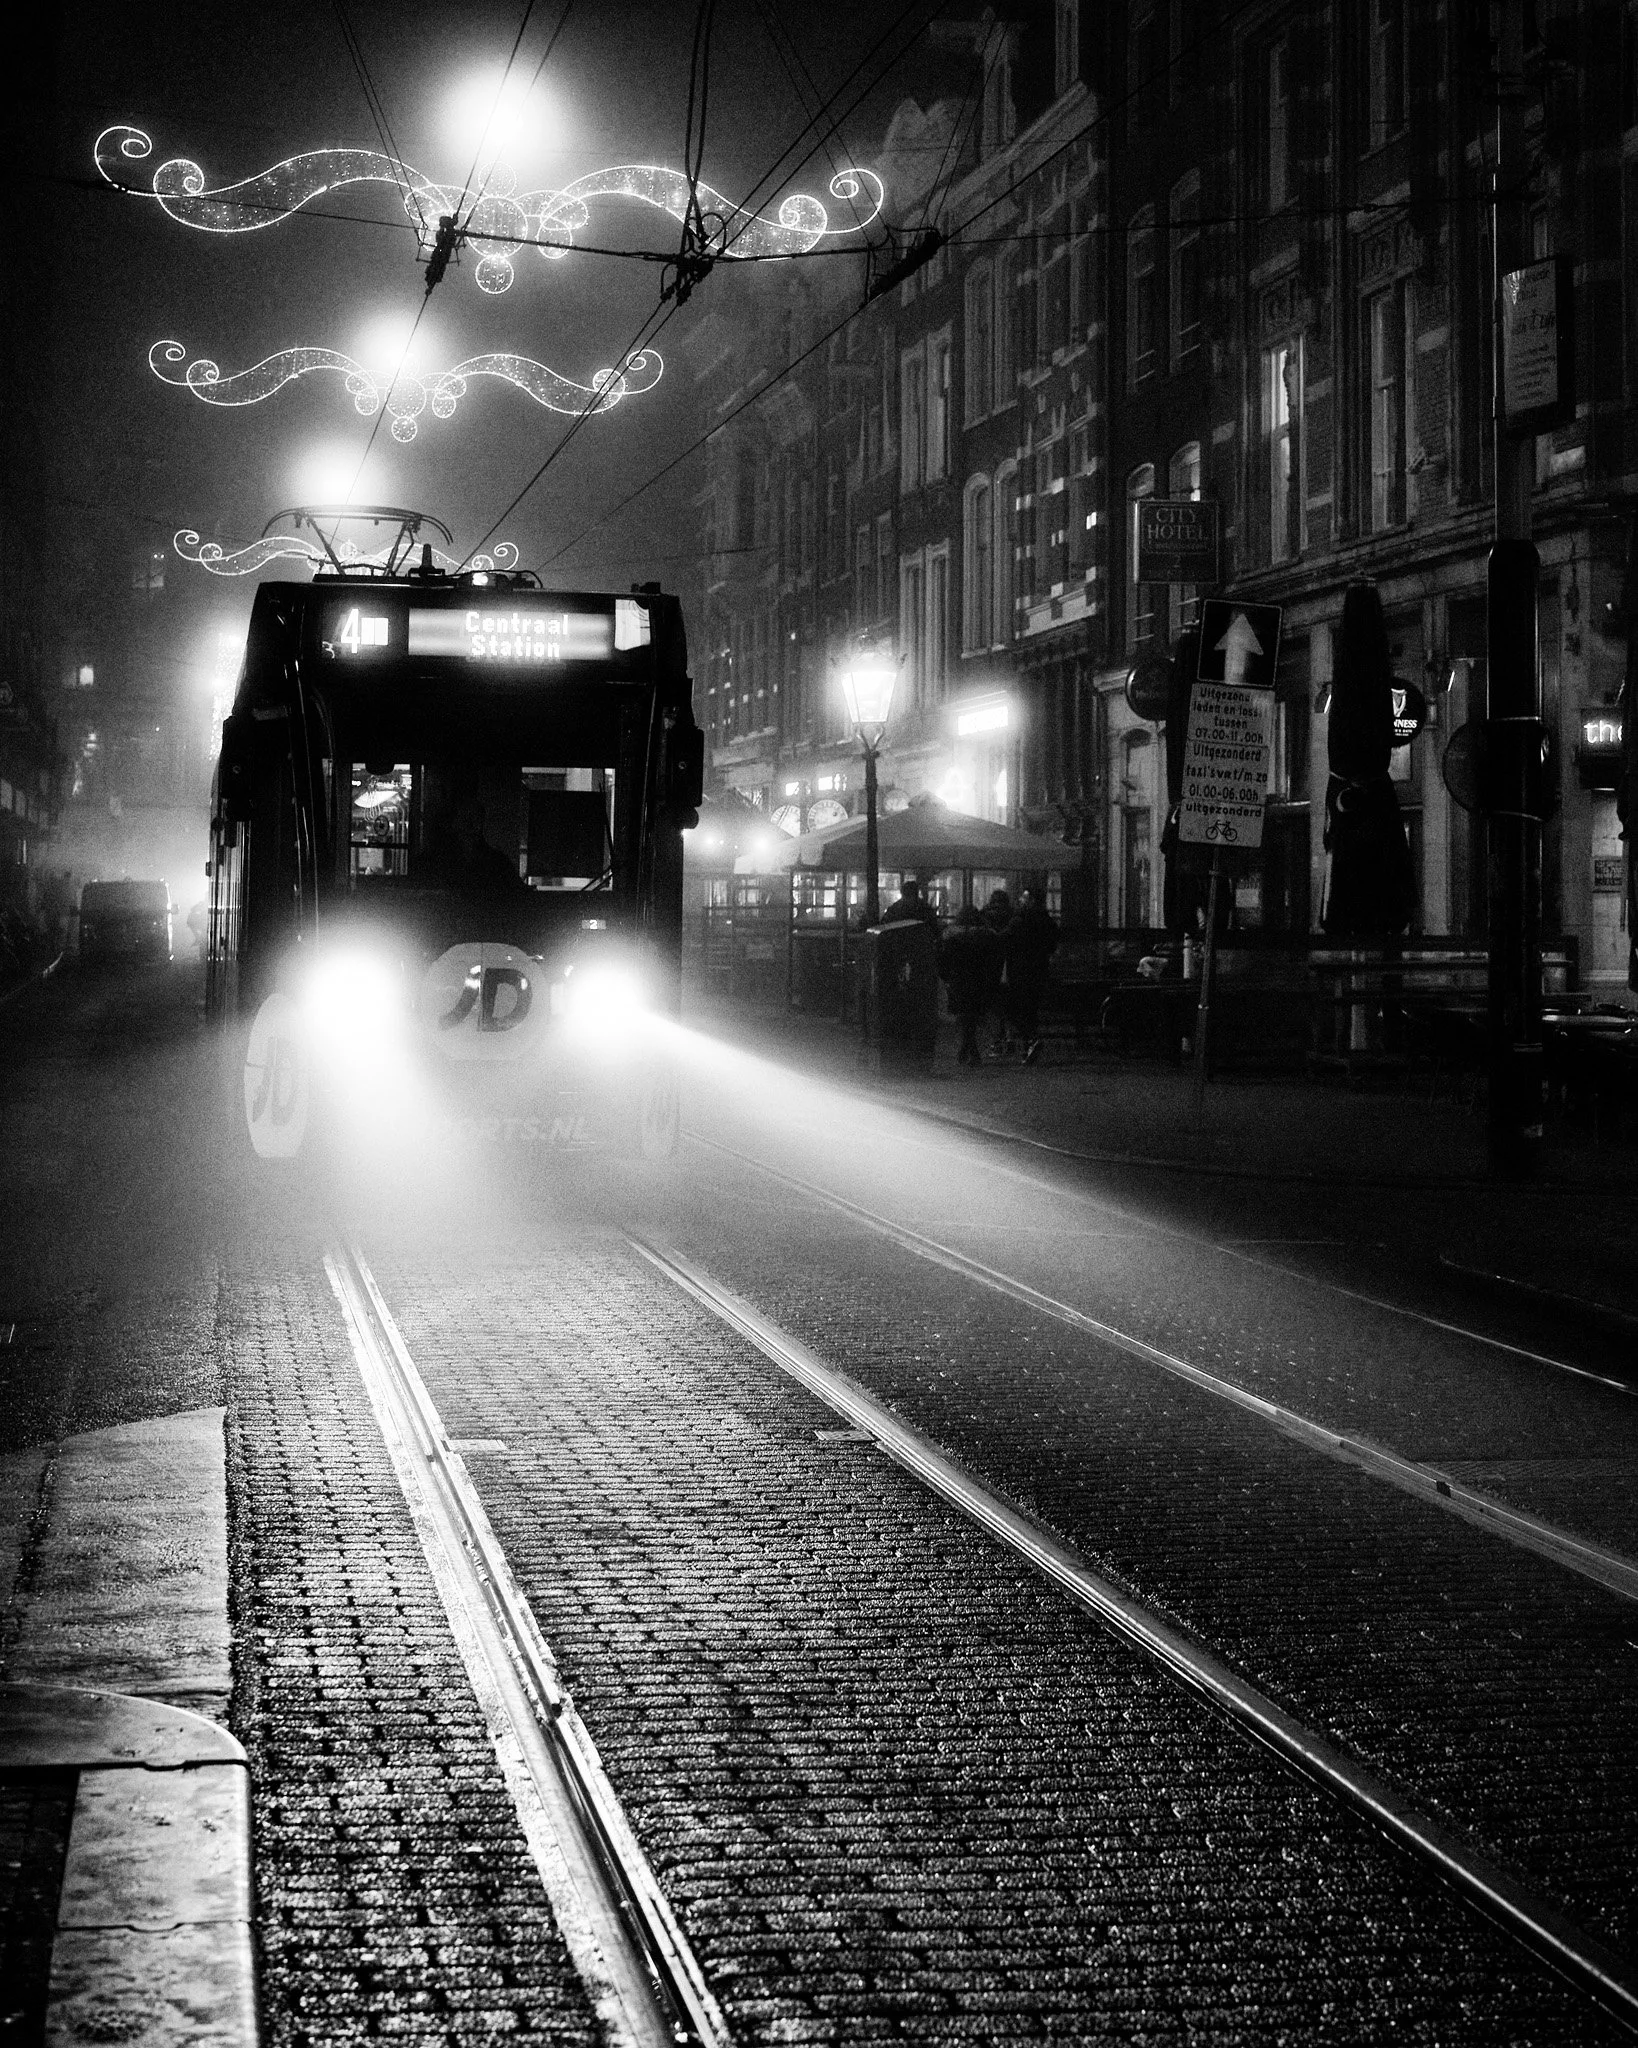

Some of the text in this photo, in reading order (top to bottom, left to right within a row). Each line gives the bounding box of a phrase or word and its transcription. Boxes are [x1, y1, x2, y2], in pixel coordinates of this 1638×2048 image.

[1156, 508, 1197, 523] CITY
[1147, 524, 1208, 539] HOTEL
[340, 608, 361, 653] 4
[465, 610, 569, 635] Centraal
[470, 634, 561, 659] Station
[1193, 701, 1221, 714] laden
[1224, 705, 1235, 715] en
[1214, 716, 1247, 729] tussen
[1195, 728, 1263, 744] 07.00-11.00h
[1193, 744, 1262, 762] Uitgezonderd
[1186, 765, 1215, 778] taxi's
[1256, 772, 1268, 783] zo
[1189, 784, 1259, 801] 01.00-06.00h
[1186, 802, 1262, 817] uitgezonderd
[589, 919, 598, 930] 2
